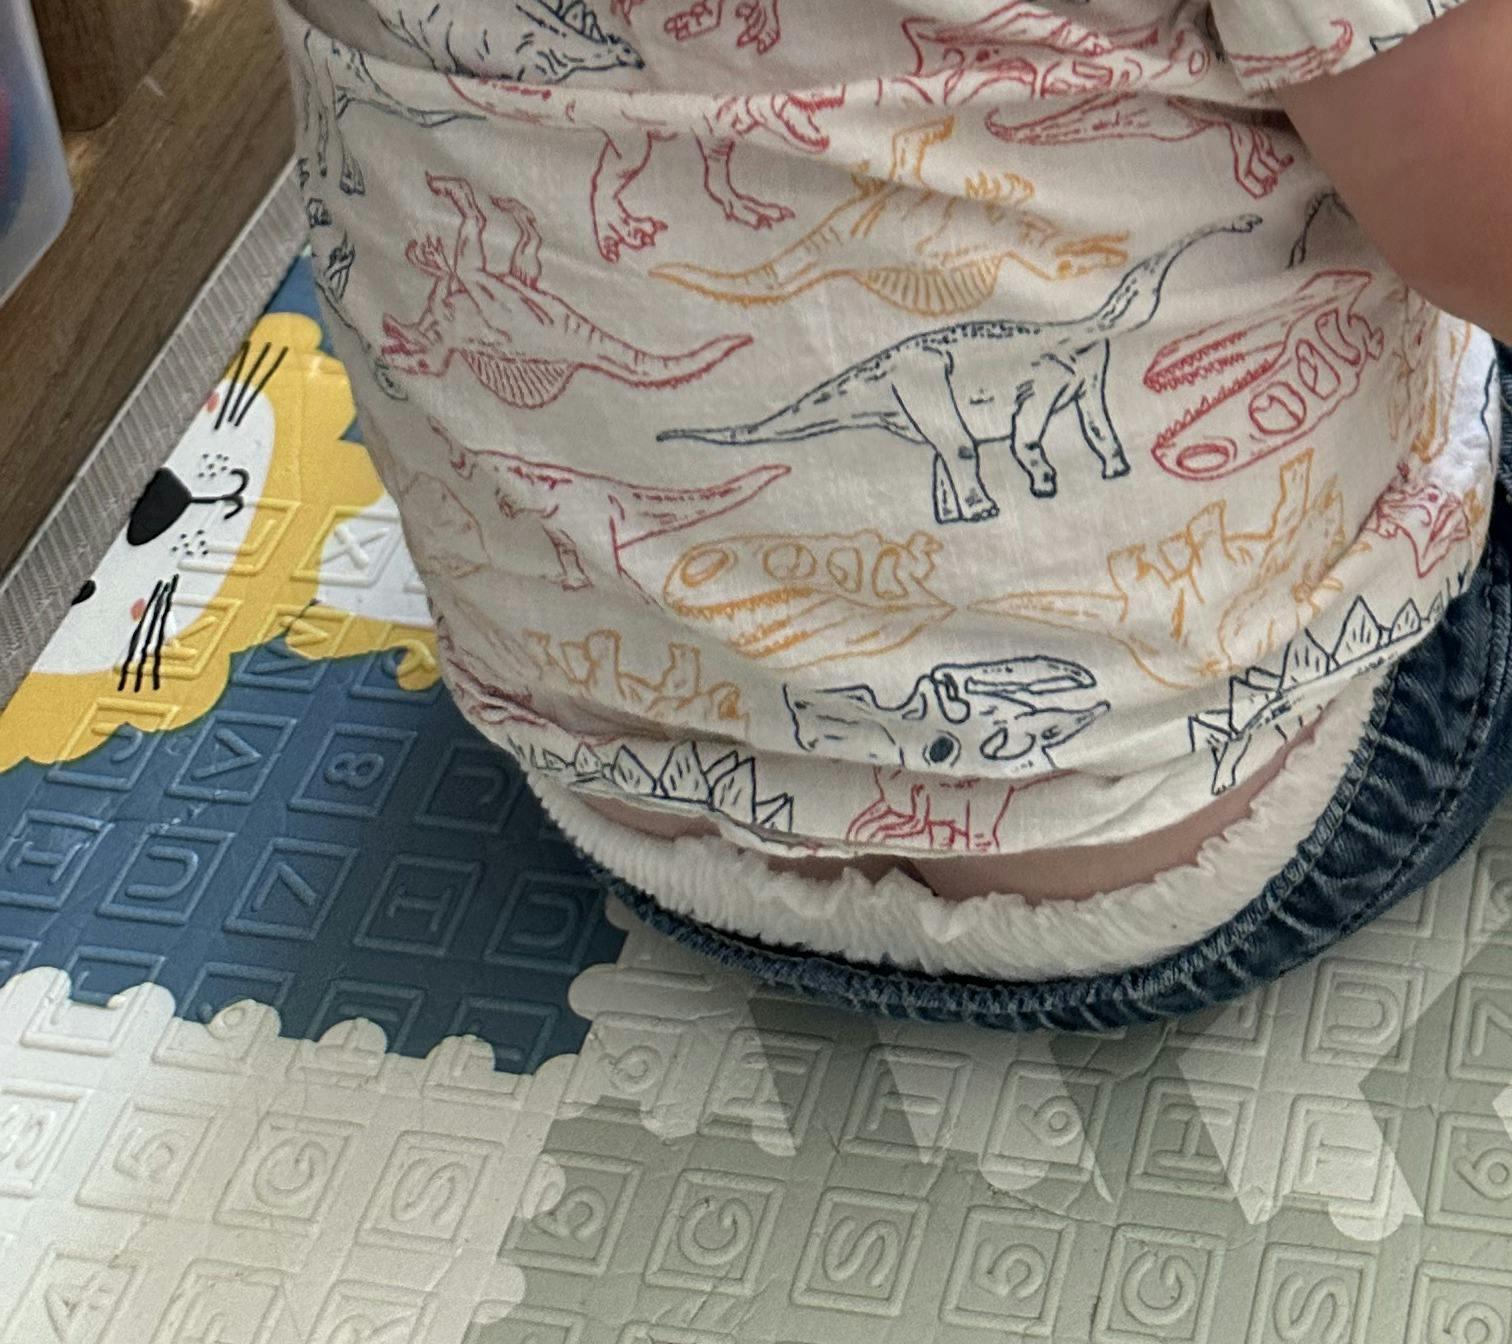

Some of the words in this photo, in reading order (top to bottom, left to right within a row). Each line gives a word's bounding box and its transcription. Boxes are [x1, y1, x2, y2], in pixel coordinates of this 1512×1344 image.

[318, 524, 391, 568] X
[190, 728, 261, 781] V
[322, 752, 385, 790] 8
[124, 843, 199, 900] U
[251, 862, 319, 911] 7
[1325, 981, 1401, 1047] U
[869, 1070, 945, 1132] T
[1016, 1095, 1088, 1147] 6
[1152, 1102, 1233, 1170] H
[1302, 1119, 1376, 1185] T
[253, 1132, 327, 1208] G
[390, 1160, 467, 1224] S
[677, 1196, 752, 1266] G
[822, 1214, 901, 1288] S
[968, 1237, 1049, 1300] 5
[1120, 1247, 1199, 1326] G
[1271, 1275, 1352, 1344] S
